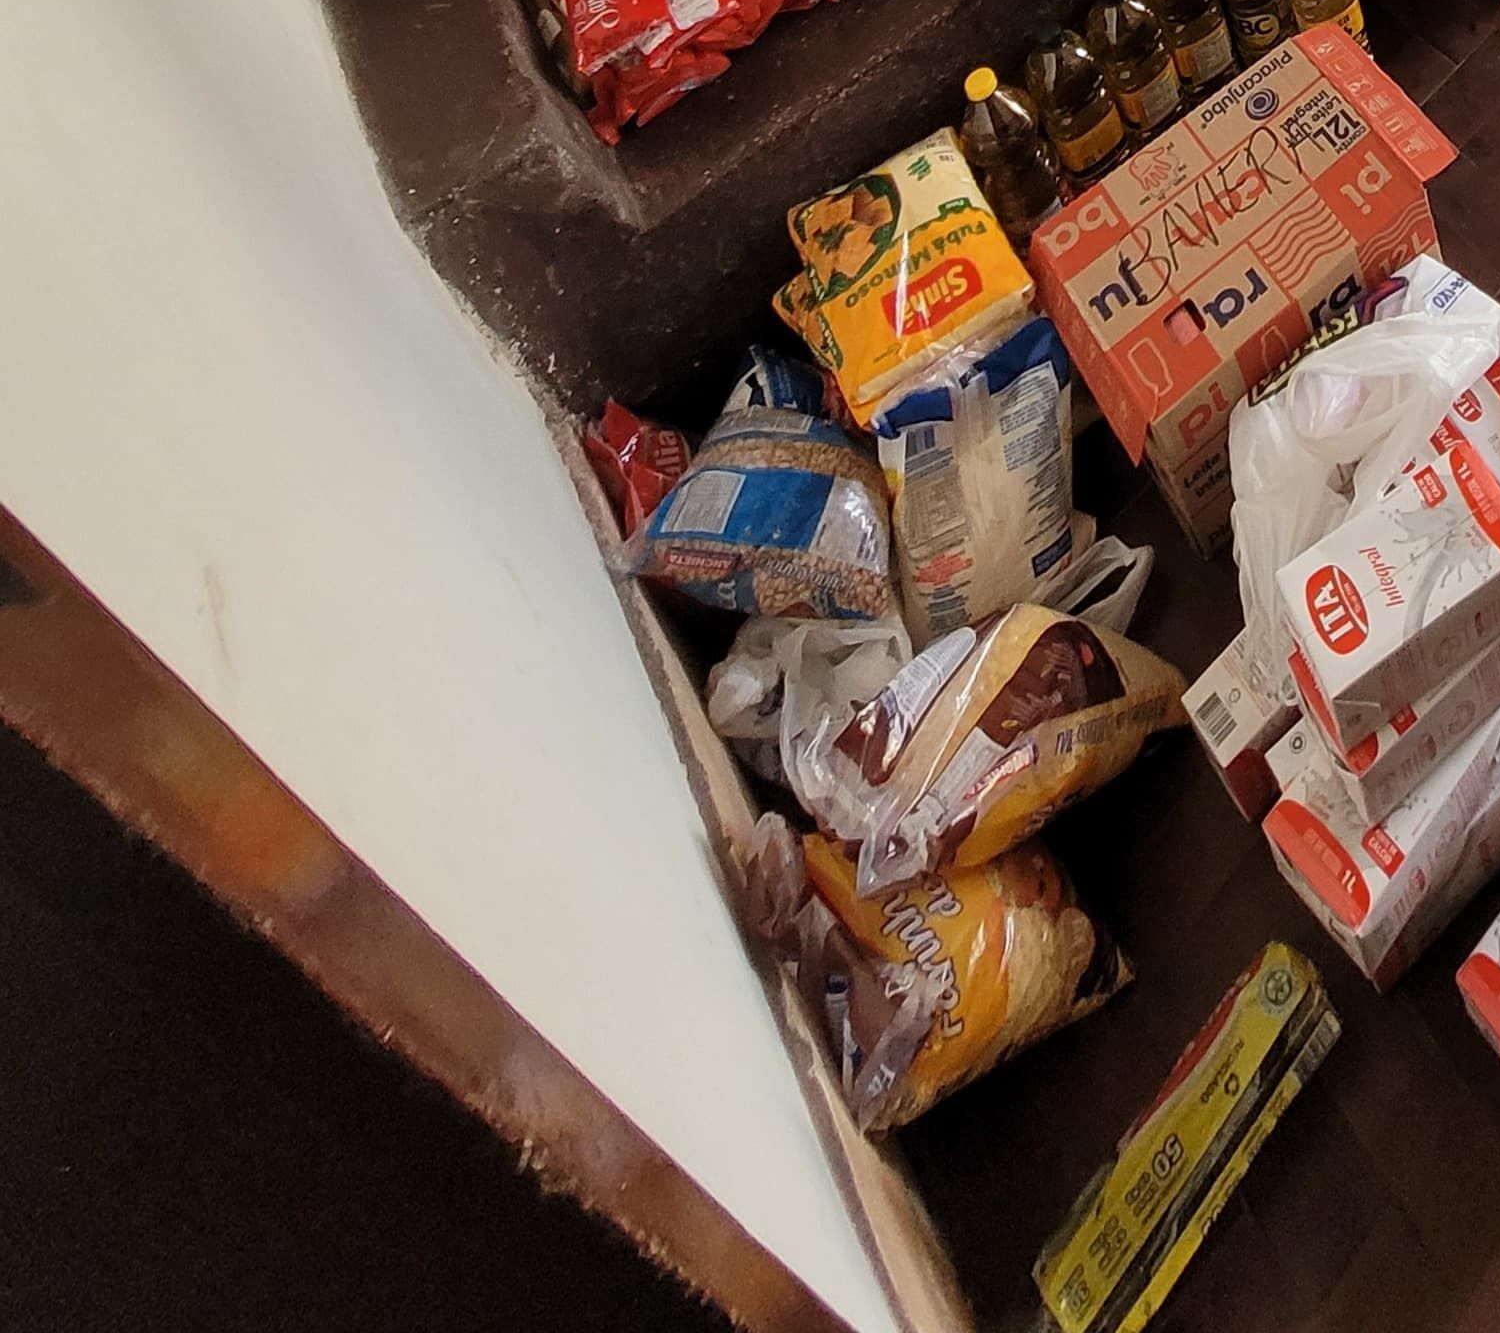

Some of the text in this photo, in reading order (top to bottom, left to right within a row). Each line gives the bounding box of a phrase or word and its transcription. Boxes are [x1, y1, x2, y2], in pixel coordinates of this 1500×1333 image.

[1238, 15, 1275, 37] BC
[1200, 49, 1294, 125] Piracanjuba
[1279, 88, 1332, 135] Integral
[1311, 95, 1342, 125] Leite
[1312, 107, 1361, 150] 12L
[1339, 150, 1393, 215] pi
[930, 220, 988, 256] Fubá
[1039, 194, 1120, 257] ba
[902, 264, 969, 330] Sinhá
[1088, 251, 1150, 323] ju
[1202, 268, 1269, 329] ra
[1178, 380, 1231, 450] pi
[1457, 462, 1471, 480] 1L
[668, 551, 735, 571] ANCHIETA
[1358, 546, 1405, 608] Integral
[1312, 580, 1355, 643] ITA
[1340, 868, 1357, 894] 1L
[881, 891, 964, 1038] Farinh
[1150, 1132, 1185, 1181] 50
